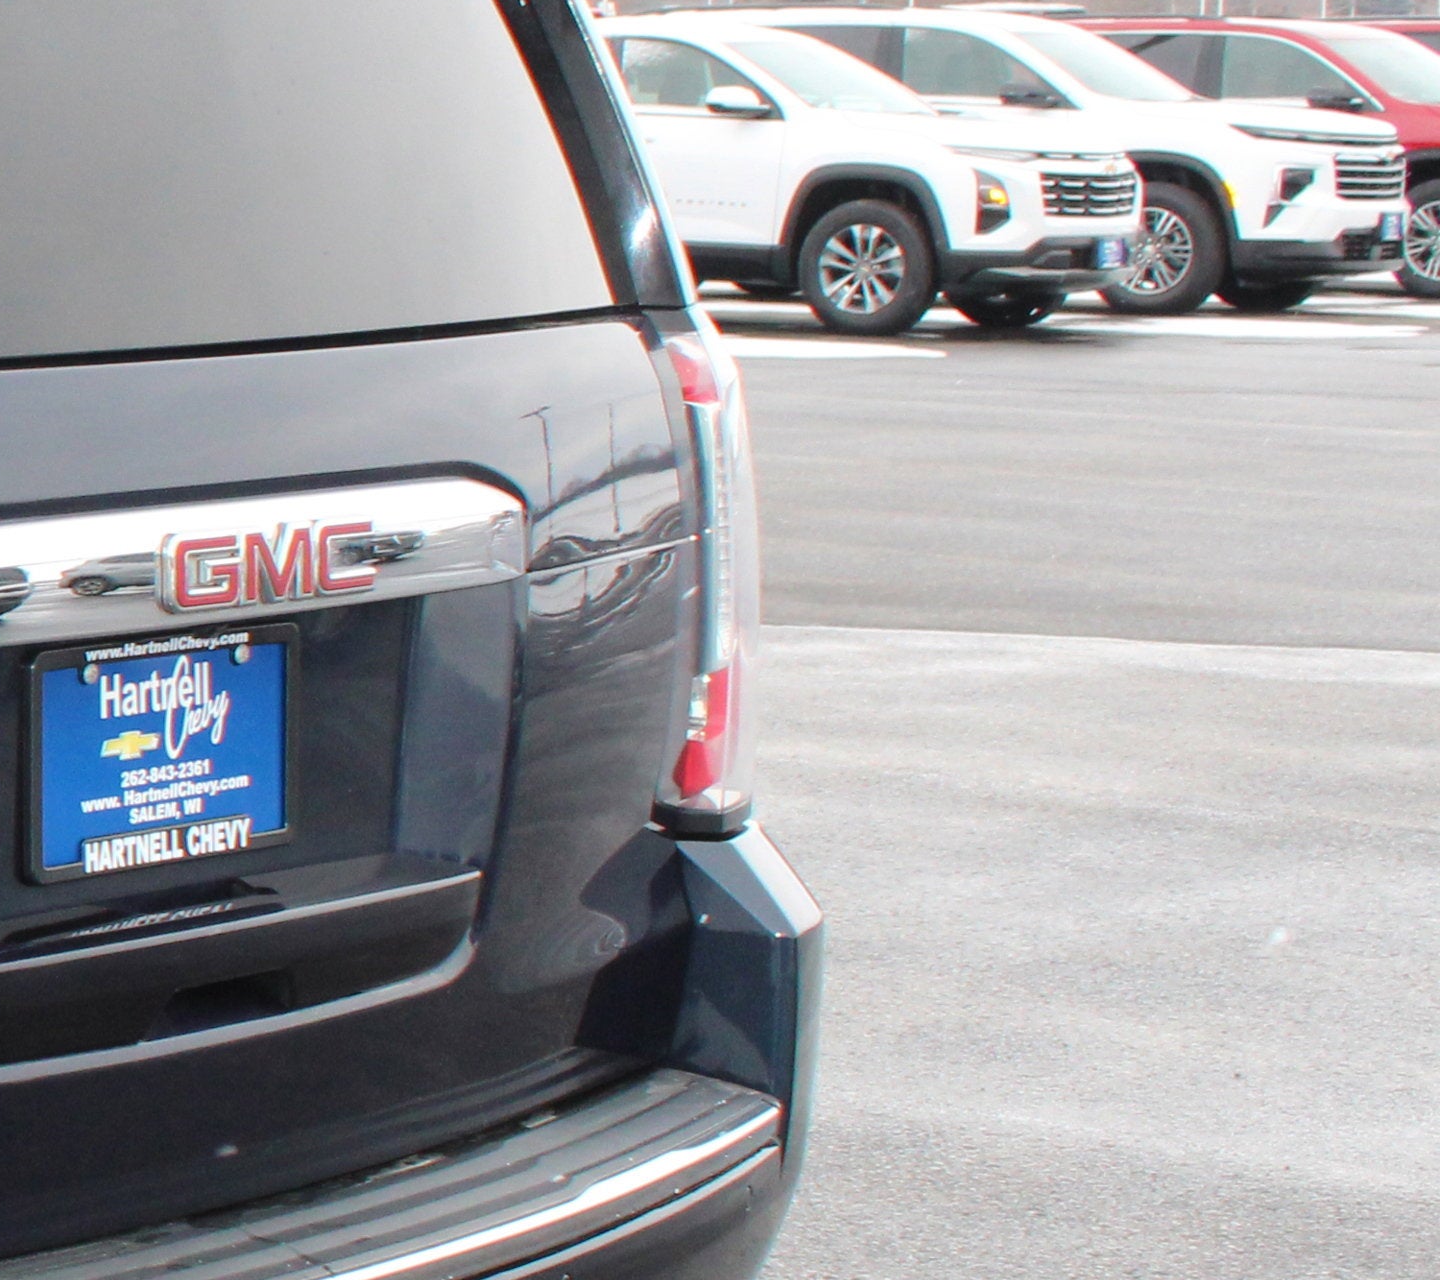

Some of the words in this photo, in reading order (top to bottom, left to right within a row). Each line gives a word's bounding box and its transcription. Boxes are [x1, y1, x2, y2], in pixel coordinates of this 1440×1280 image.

[164, 519, 377, 612] GMC
[85, 631, 250, 662] www.HartnellChevy.com
[99, 661, 211, 719] Hartnell
[165, 654, 229, 760] Chevy
[121, 758, 211, 788] 262-843-2361
[129, 801, 181, 824] SALEM,
[183, 797, 203, 815] WI
[84, 829, 185, 874] HARTNELL
[186, 817, 251, 857] CHEVY
